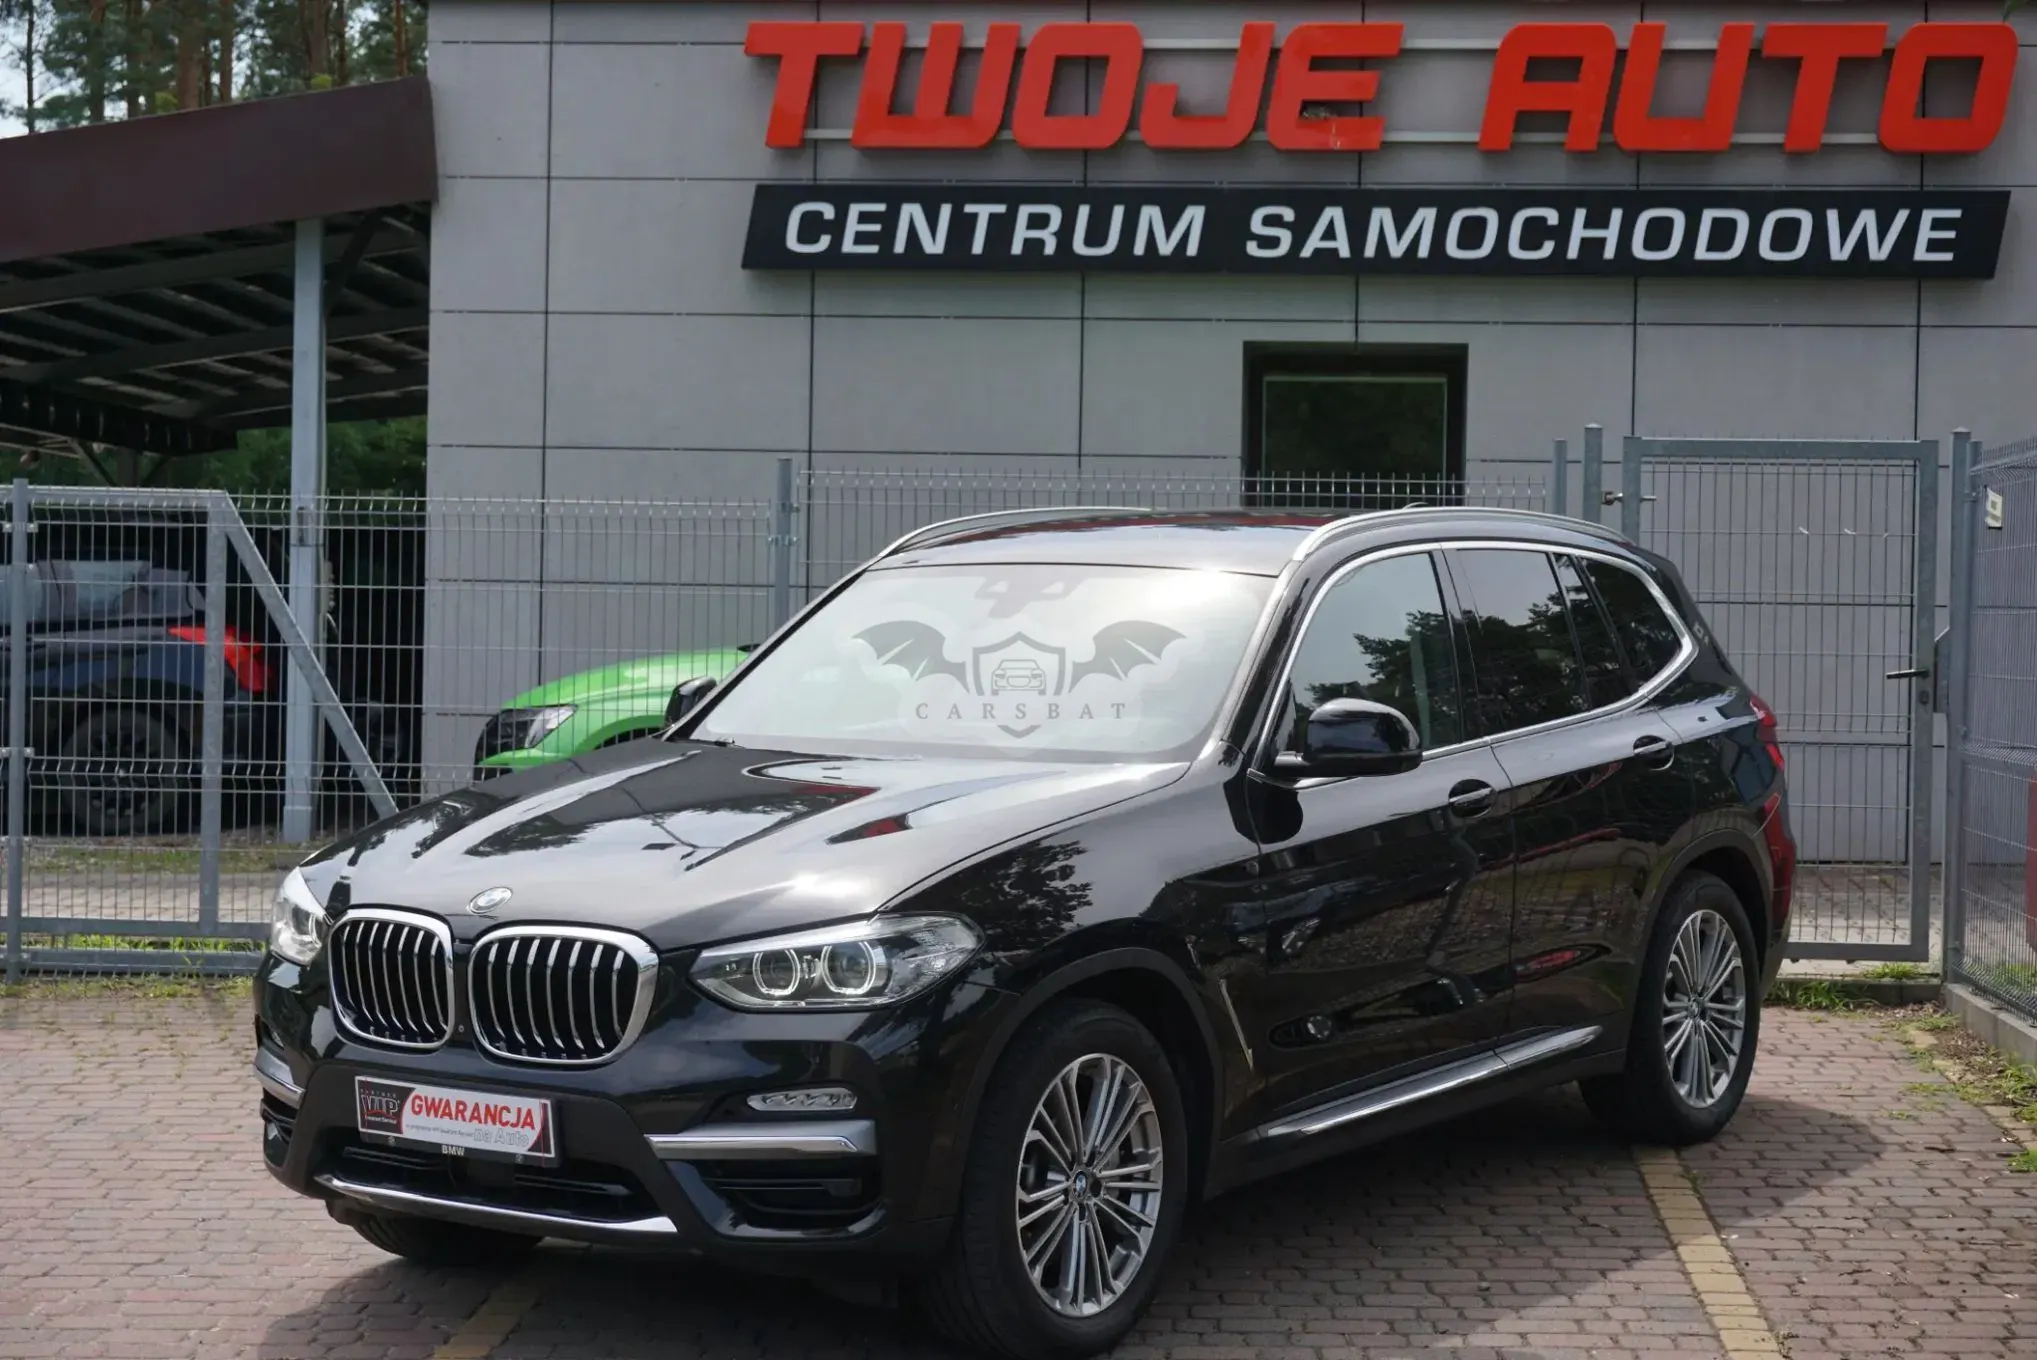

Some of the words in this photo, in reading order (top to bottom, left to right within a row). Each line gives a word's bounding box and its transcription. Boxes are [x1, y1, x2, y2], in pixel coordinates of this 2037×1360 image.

[744, 21, 1404, 151] TWOJE
[1477, 22, 2019, 153] AUTO
[784, 202, 1206, 257] CENTRUM
[1245, 205, 1962, 262] SAMOCHODOWE
[411, 1094, 535, 1131] GWARANCJA
[441, 1144, 465, 1157] BMW
